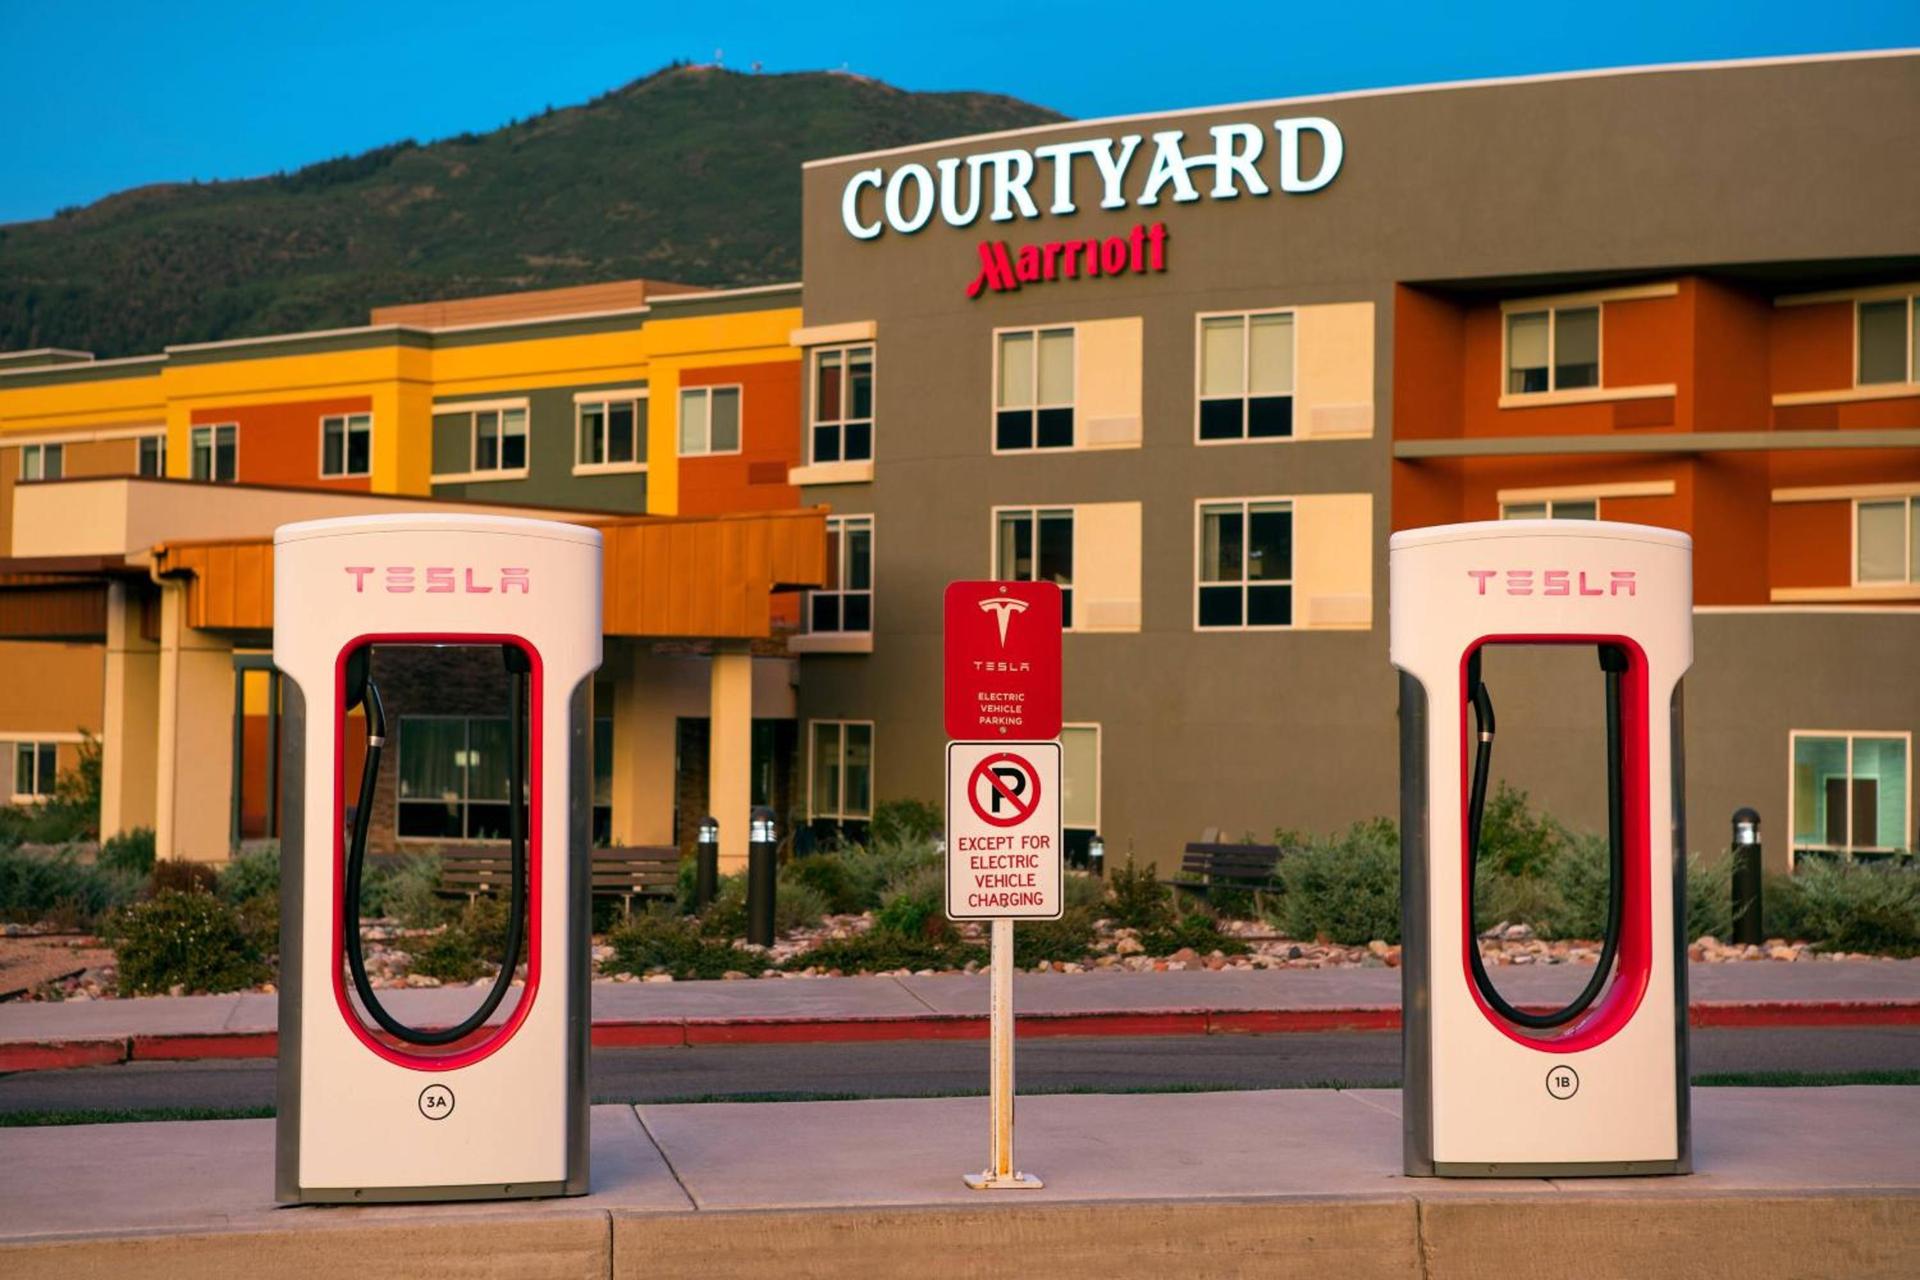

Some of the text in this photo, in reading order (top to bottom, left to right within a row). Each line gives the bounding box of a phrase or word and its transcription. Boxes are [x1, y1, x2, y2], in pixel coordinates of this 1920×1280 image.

[841, 116, 1344, 240] COURTYARD
[967, 222, 1167, 298] Marriott
[344, 566, 530, 594] TESLA
[1467, 570, 1636, 596] TESLA
[973, 661, 1030, 671] TESLA
[978, 692, 1024, 701] ELECTRIC
[980, 705, 1022, 713] VEHICLE
[979, 716, 1023, 725] PARKING
[958, 835, 1050, 851] EXCEPT FOR
[970, 855, 1039, 870] ELECTRIC
[975, 874, 1036, 888] VEHICLE
[968, 892, 1043, 908] CHARGING
[1555, 1076, 1570, 1088] 1B
[427, 1096, 446, 1108] 3A
